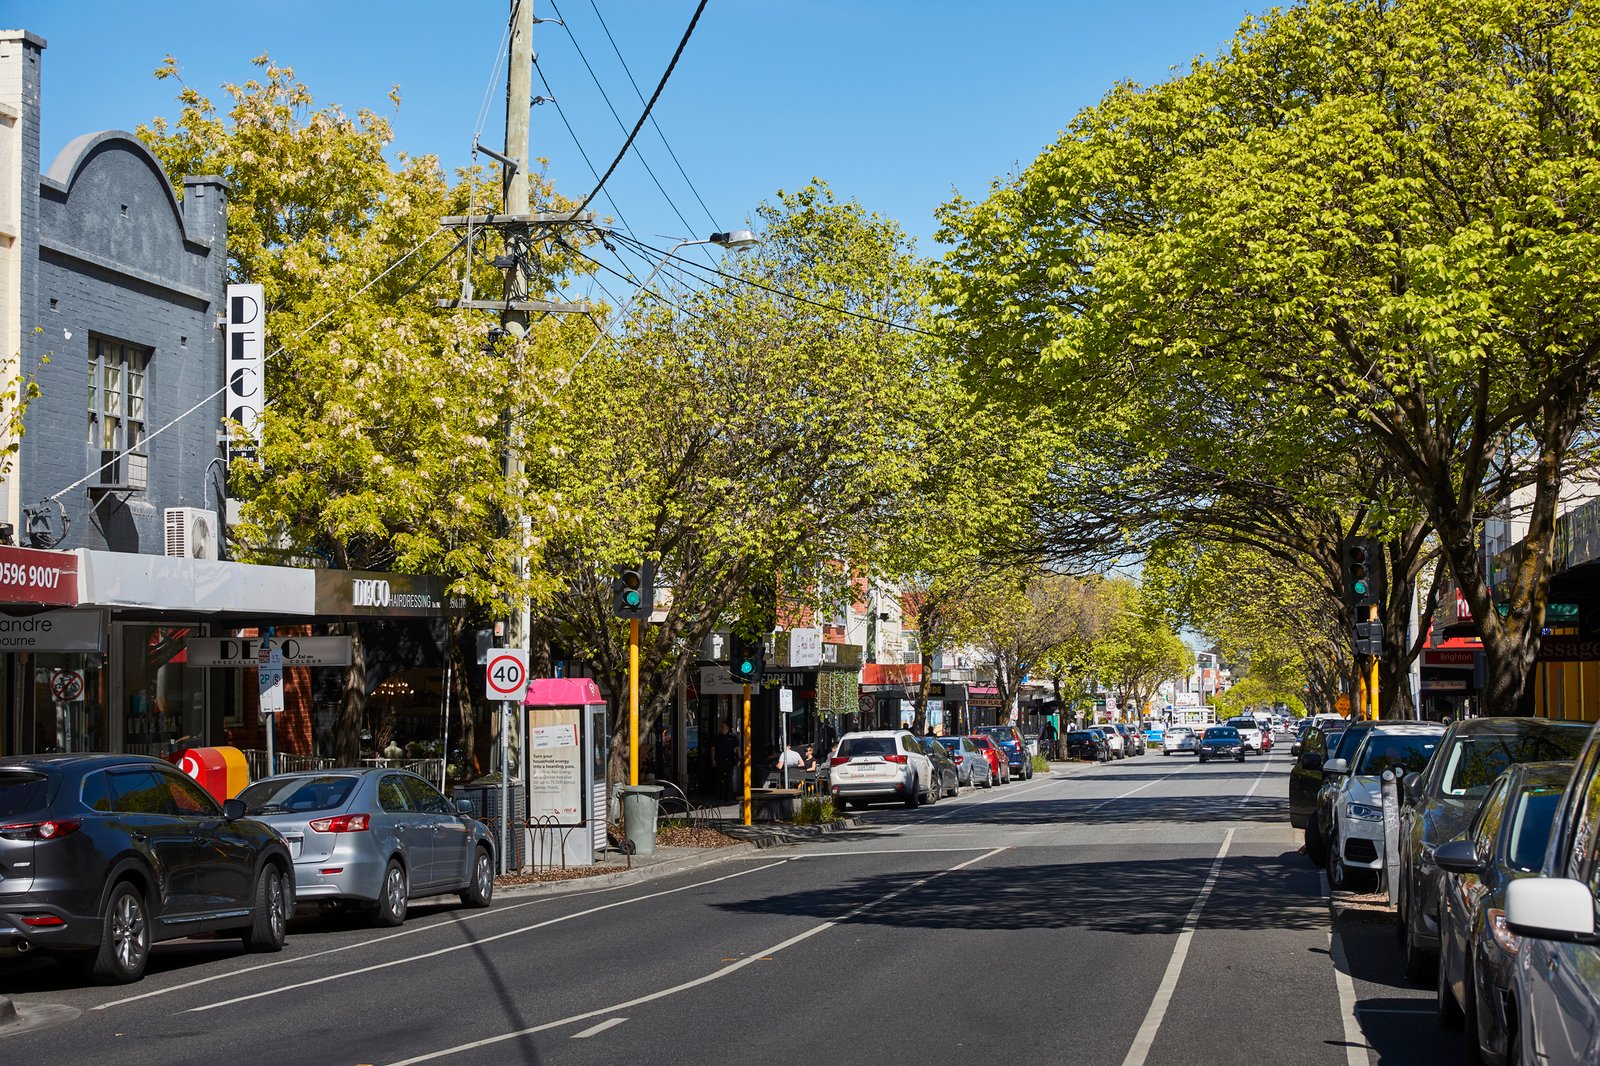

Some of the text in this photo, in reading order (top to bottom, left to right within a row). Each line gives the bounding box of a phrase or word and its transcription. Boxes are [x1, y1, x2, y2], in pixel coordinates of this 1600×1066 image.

[230, 296, 258, 434] DECO
[29, 565, 60, 589] 9007
[353, 579, 390, 607] DECO
[389, 594, 431, 608] HAIRDRESSING
[1440, 652, 1472, 661] Brighton
[1539, 642, 1600, 660] ssage
[260, 674, 270, 684] 2P
[493, 666, 519, 682] 40
[761, 673, 804, 686] EPPELIN
